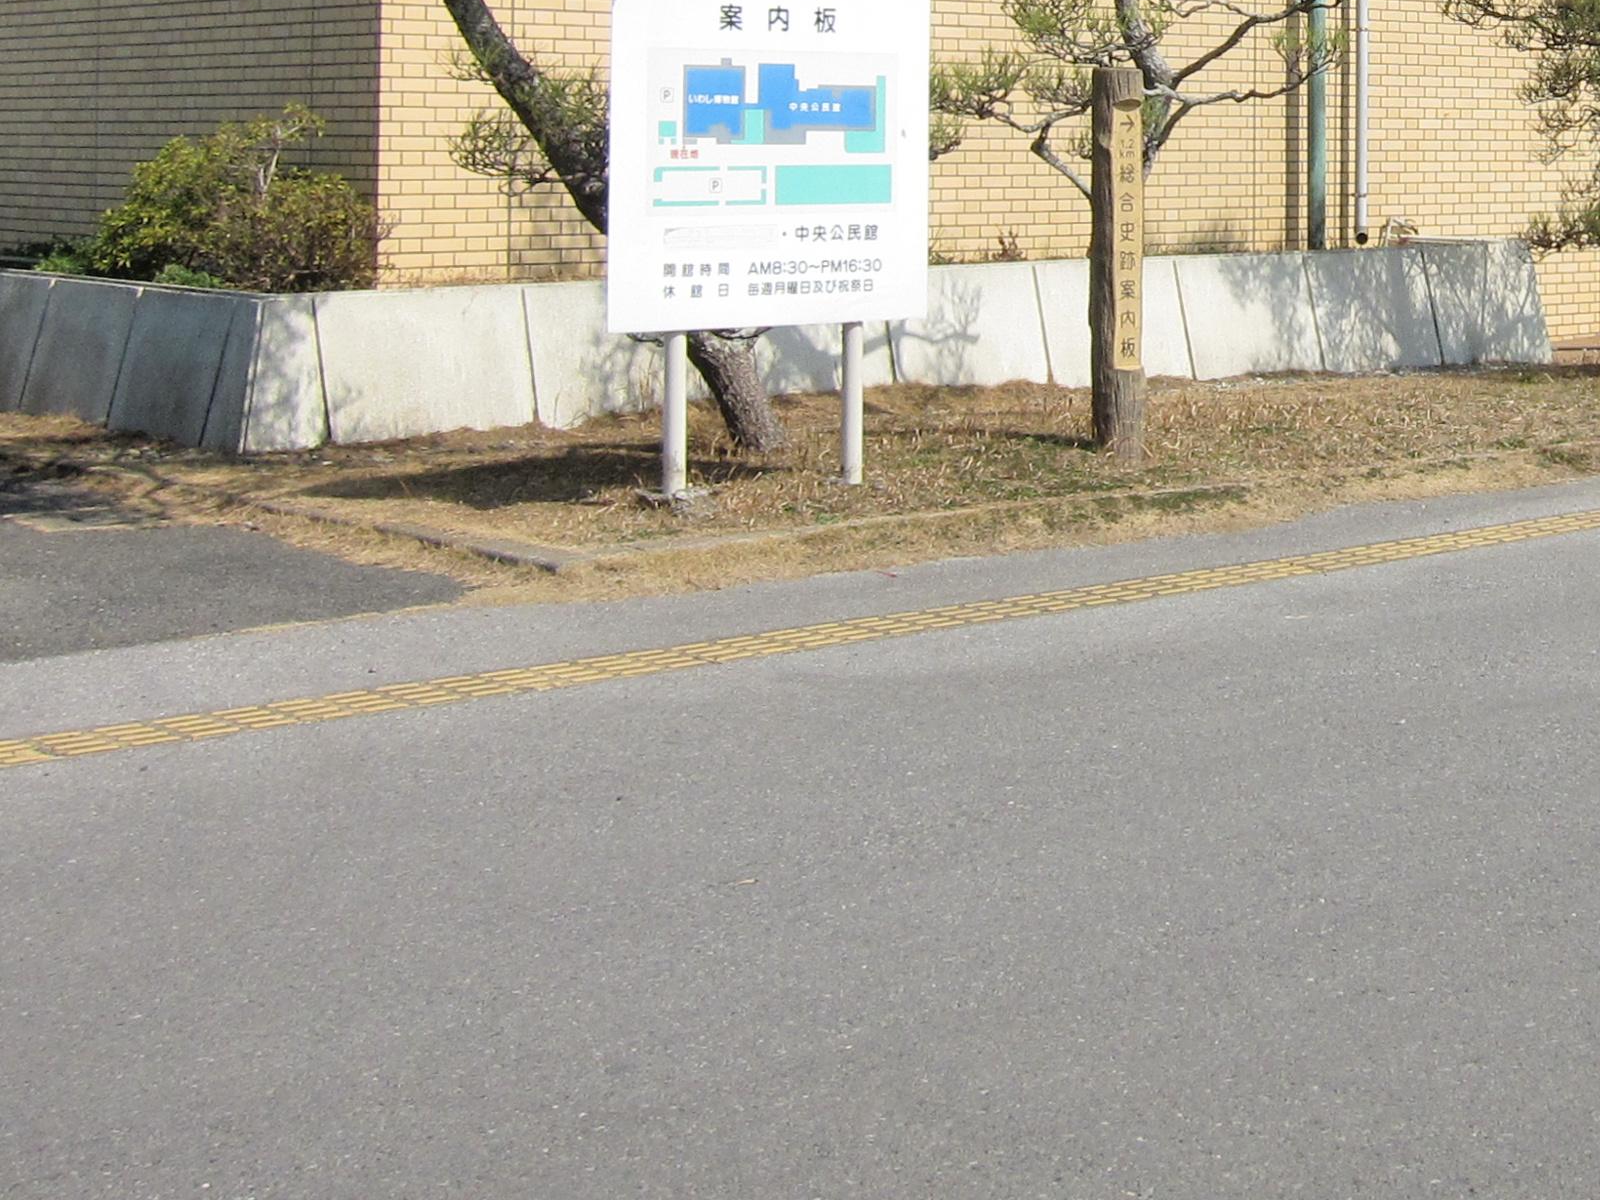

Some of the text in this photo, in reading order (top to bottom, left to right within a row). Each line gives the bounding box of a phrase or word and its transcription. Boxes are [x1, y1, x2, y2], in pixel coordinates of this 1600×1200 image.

[719, 3, 837, 34] 案内板
[662, 89, 672, 100] P
[711, 180, 720, 191] P
[1119, 163, 1137, 359] 総合史跡案内板
[663, 282, 730, 299] 休館日
